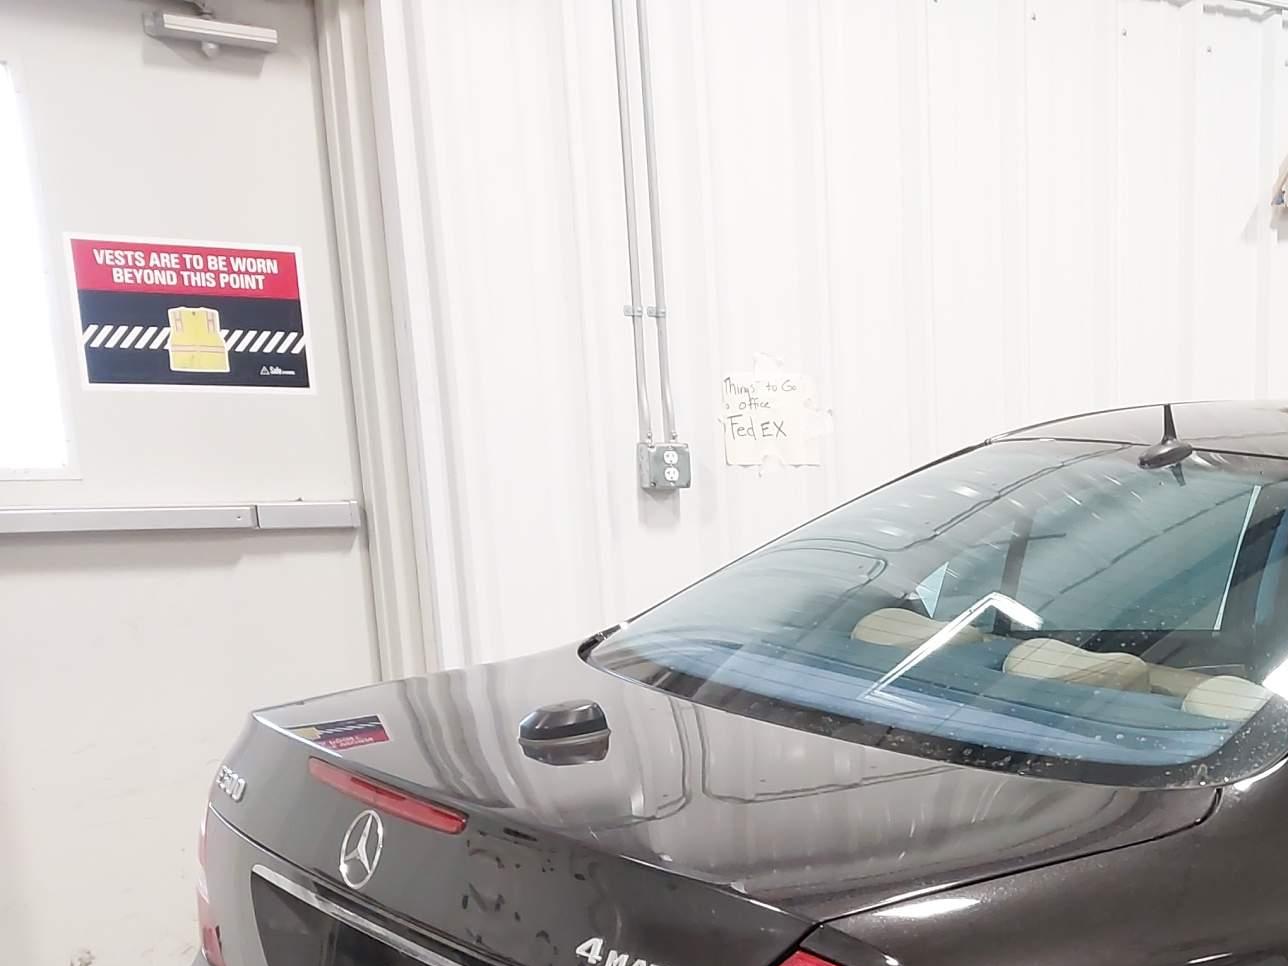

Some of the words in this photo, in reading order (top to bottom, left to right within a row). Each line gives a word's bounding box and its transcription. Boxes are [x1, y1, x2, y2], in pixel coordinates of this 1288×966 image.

[93, 249, 146, 267] VESTS
[149, 252, 180, 269] ARE
[183, 254, 204, 271] TO
[207, 255, 229, 272] BE
[230, 256, 279, 275] WORN
[112, 268, 178, 286] BEYOND
[181, 271, 217, 288] THIS
[220, 273, 266, 290] POINT
[766, 381, 778, 393] to
